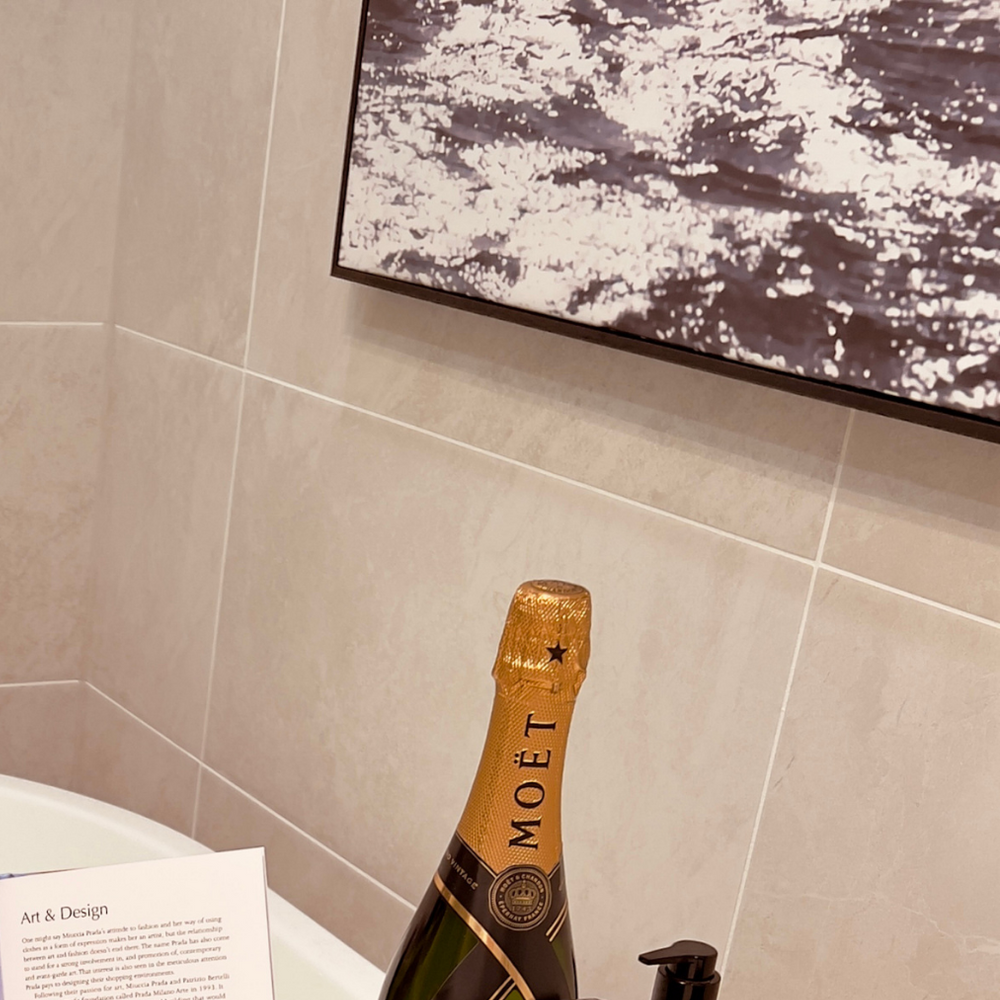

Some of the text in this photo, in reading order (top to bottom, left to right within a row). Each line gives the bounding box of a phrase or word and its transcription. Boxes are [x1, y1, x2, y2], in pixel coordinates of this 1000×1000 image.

[508, 710, 557, 850] MOËT
[449, 861, 479, 890] VINTAGE
[20, 903, 109, 925] Art & Design
